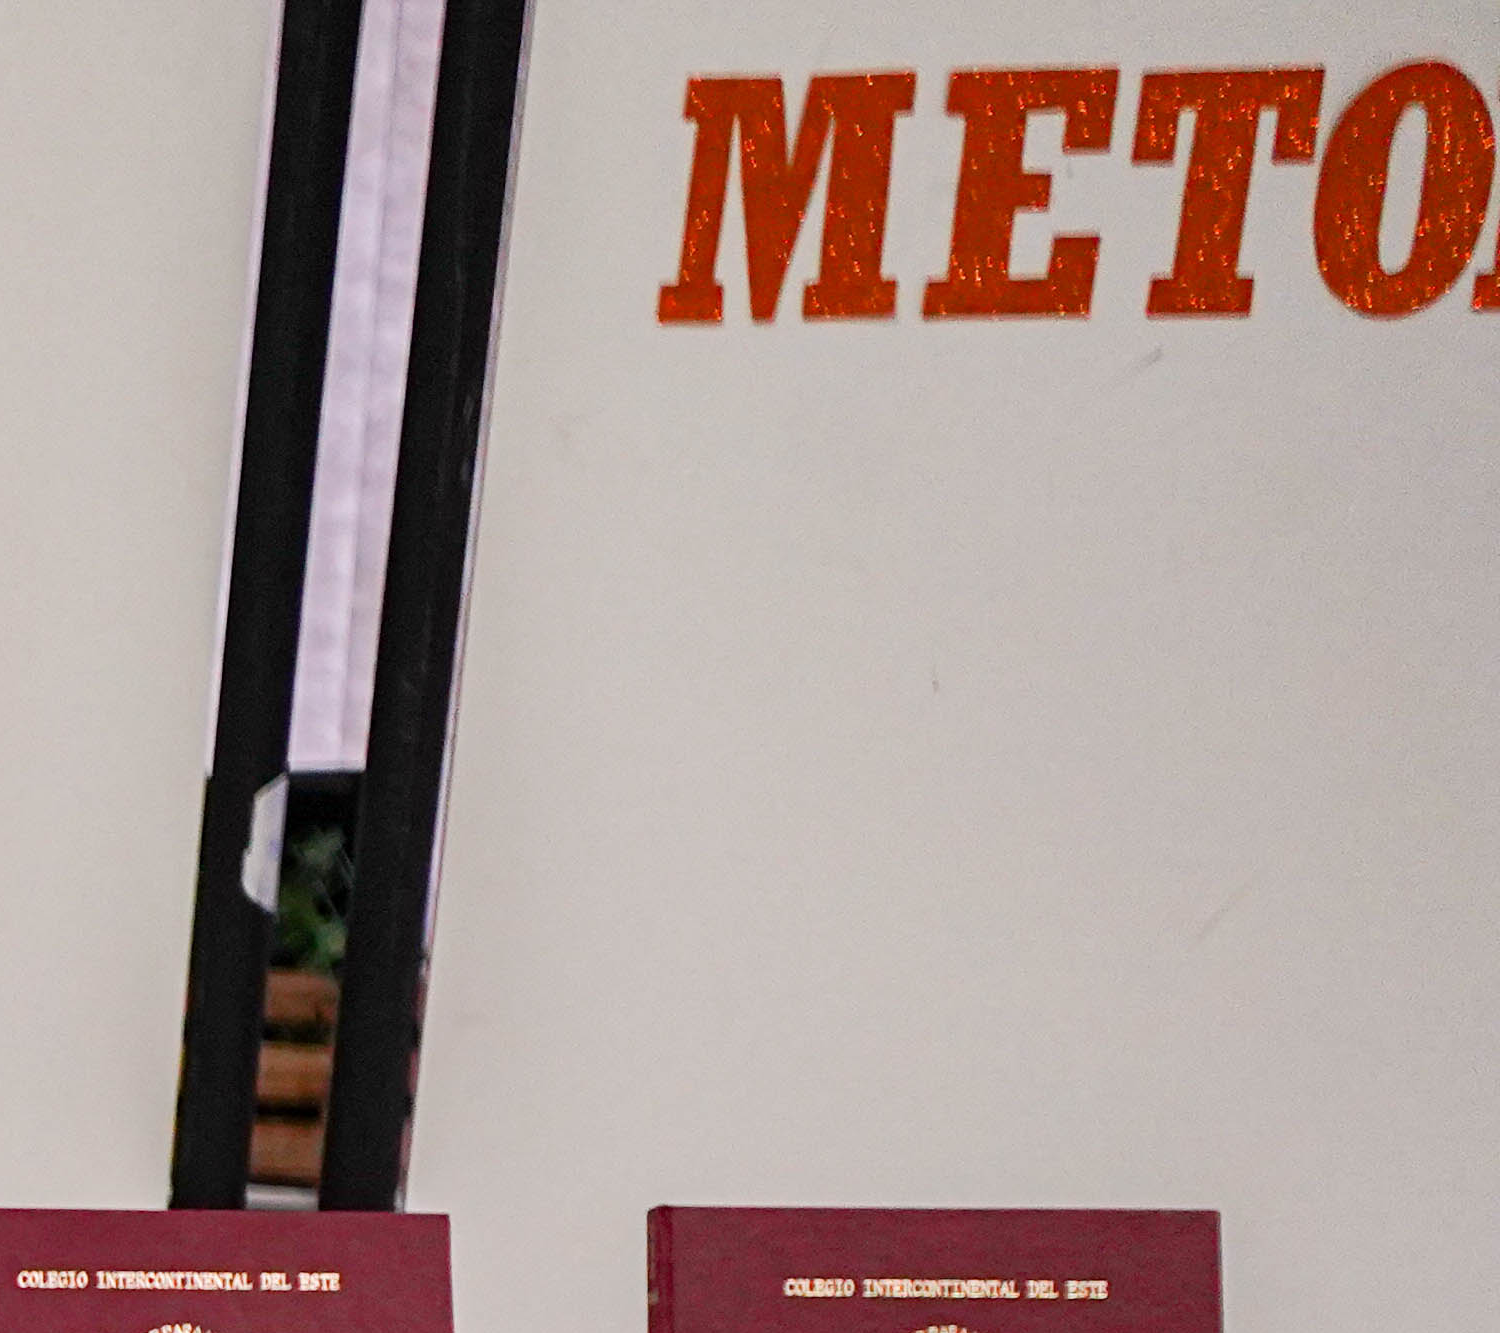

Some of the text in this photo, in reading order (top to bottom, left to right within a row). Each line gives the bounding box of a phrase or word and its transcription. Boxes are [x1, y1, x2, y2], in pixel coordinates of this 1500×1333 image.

[656, 56, 1500, 325] METO
[16, 1271, 340, 1291] COLEGIO INTERCONTINENTAL DEL ESTE
[782, 1278, 856, 1297] COLEGIO
[1025, 1280, 1060, 1299] DEL
[1064, 1280, 1109, 1299] ESTE
